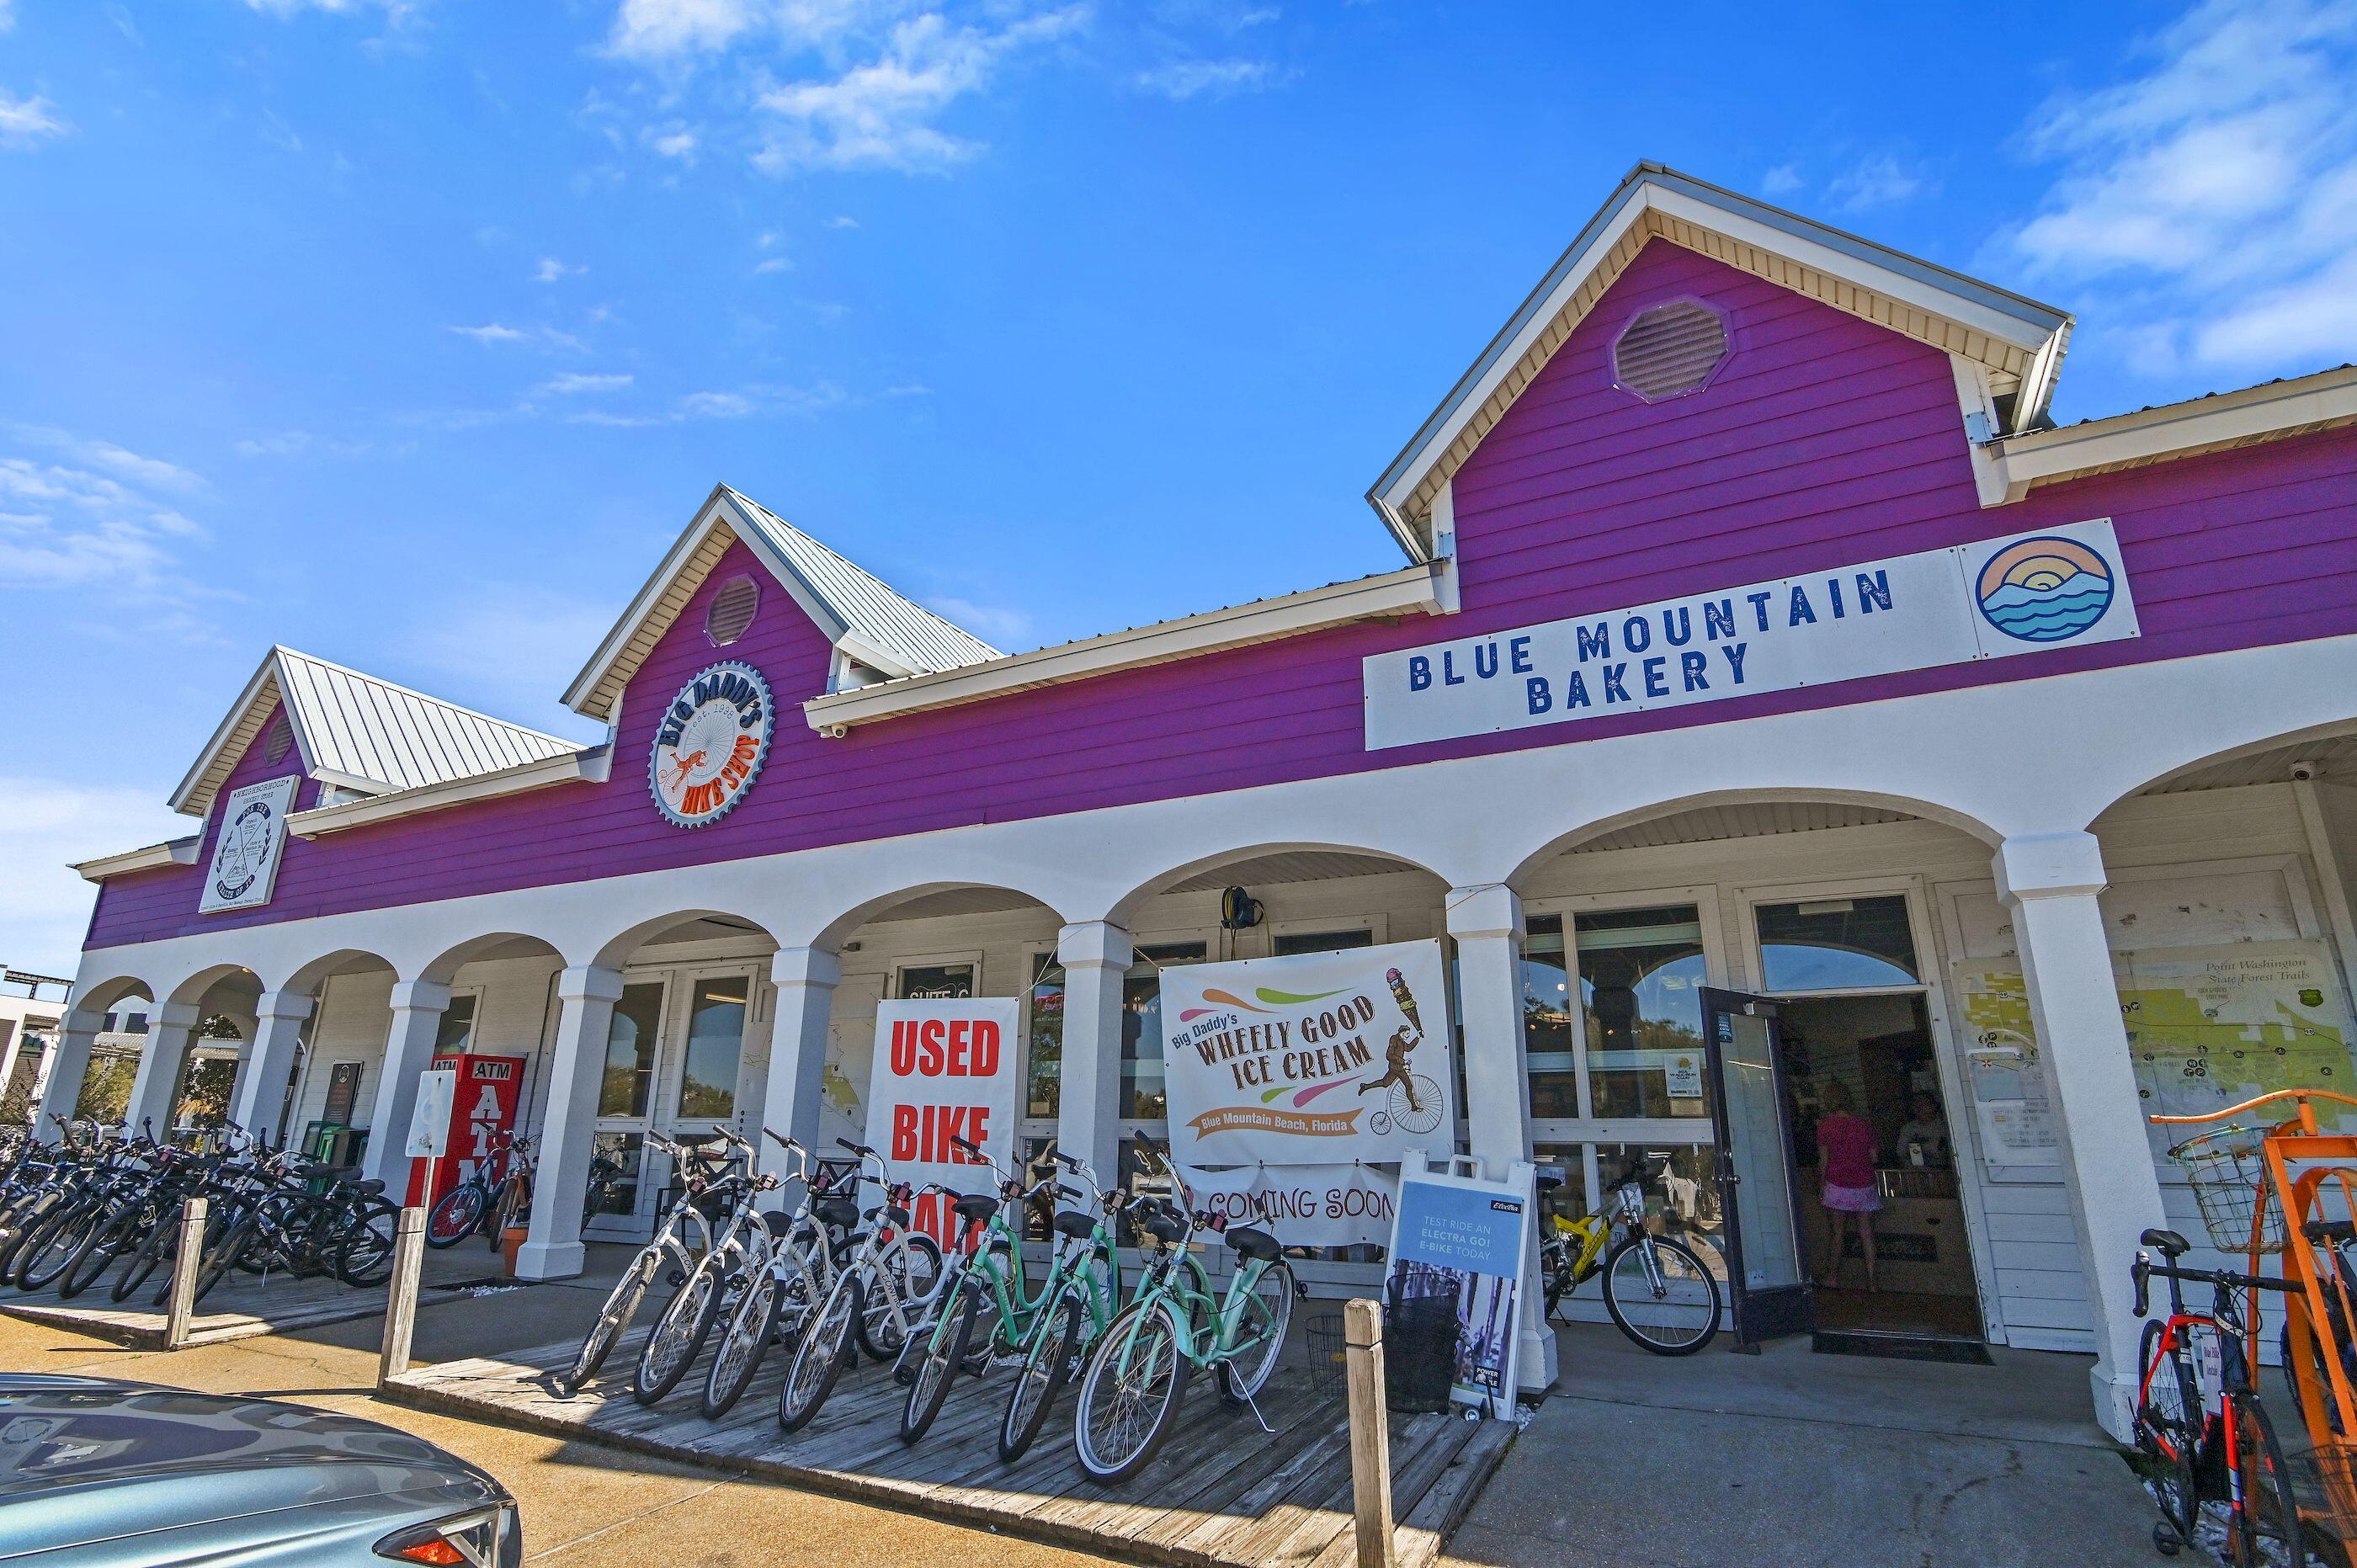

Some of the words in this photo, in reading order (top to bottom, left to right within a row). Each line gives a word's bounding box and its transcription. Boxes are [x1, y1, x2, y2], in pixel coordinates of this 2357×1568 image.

[1409, 635, 1531, 693] BLUE
[1578, 569, 1892, 663] MOUNTAIN
[1527, 642, 1749, 715] BAKERY
[658, 700, 695, 747] BIG
[693, 672, 763, 731] DADDY'S
[692, 710, 710, 728] est.
[714, 704, 735, 720] 1998
[680, 777, 725, 814] BIKE
[721, 735, 760, 789] SHOP
[236, 779, 286, 799] NEIGHBORHOOD
[2205, 962, 2235, 972] Point
[2238, 959, 2306, 970] Washington
[2208, 975, 2237, 984] State
[2240, 973, 2273, 983] Forest
[2277, 970, 2310, 981] Trails
[1171, 1032, 1191, 1050] Big
[1192, 1013, 1238, 1039] Daddy's
[1194, 1020, 1291, 1066] WHEELY
[1301, 995, 1376, 1044] GOOD
[891, 1019, 1000, 1076] USED
[474, 1061, 510, 1079] ATM
[1231, 1055, 1275, 1090] ICE
[1282, 1034, 1375, 1080] CREAM
[1200, 1116, 1221, 1129] Blue
[1223, 1113, 1272, 1126] Mountain
[1274, 1117, 1309, 1132] Beach,
[1312, 1119, 1348, 1131] Florida
[891, 1104, 990, 1166] BIKE
[1209, 1188, 1317, 1220] COMING
[1492, 1202, 1519, 1212] Electra
[1422, 1228, 1466, 1243] ELECTRA
[1470, 1236, 1490, 1247] GO!
[1424, 1216, 1447, 1227] TEST
[1450, 1220, 1472, 1231] RIDE
[1476, 1225, 1491, 1235] AN
[1420, 1241, 1452, 1254] E-BIKE
[1456, 1246, 1491, 1260] TODAY
[1476, 1367, 1498, 1378] POWER
